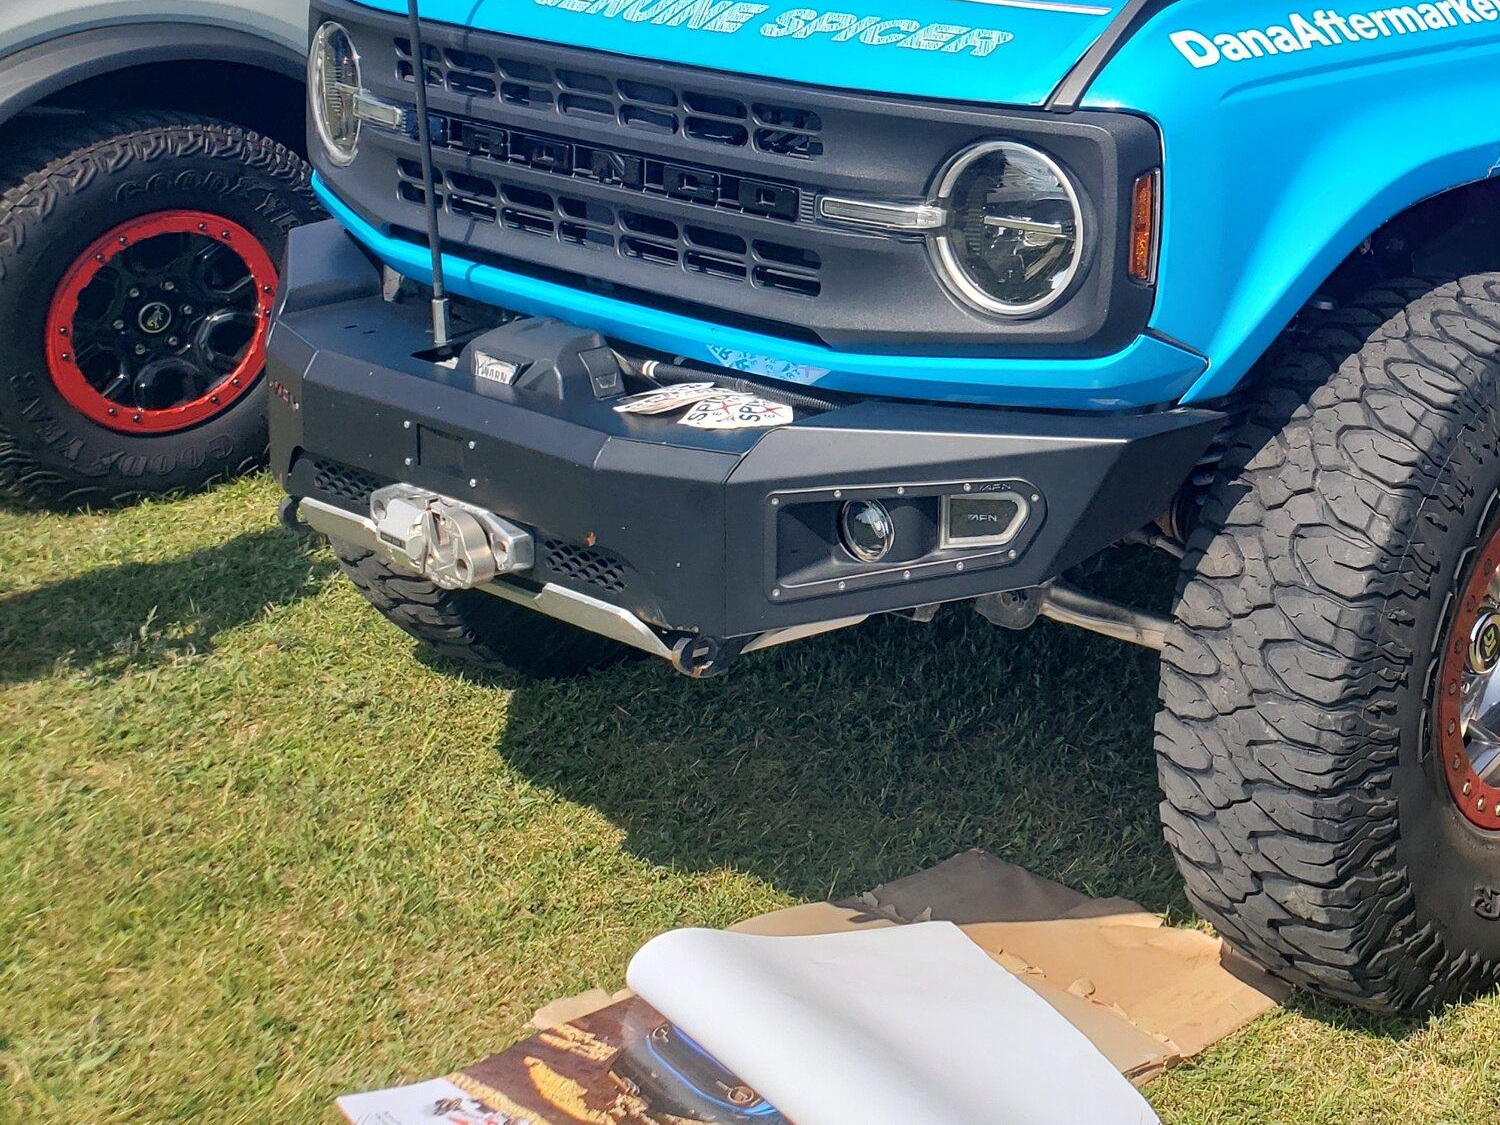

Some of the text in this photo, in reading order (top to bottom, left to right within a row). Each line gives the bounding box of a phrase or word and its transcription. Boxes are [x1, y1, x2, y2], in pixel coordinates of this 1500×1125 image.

[760, 8, 1014, 57] SPICER
[405, 109, 801, 224] BRONCO
[481, 365, 508, 383] WARN
